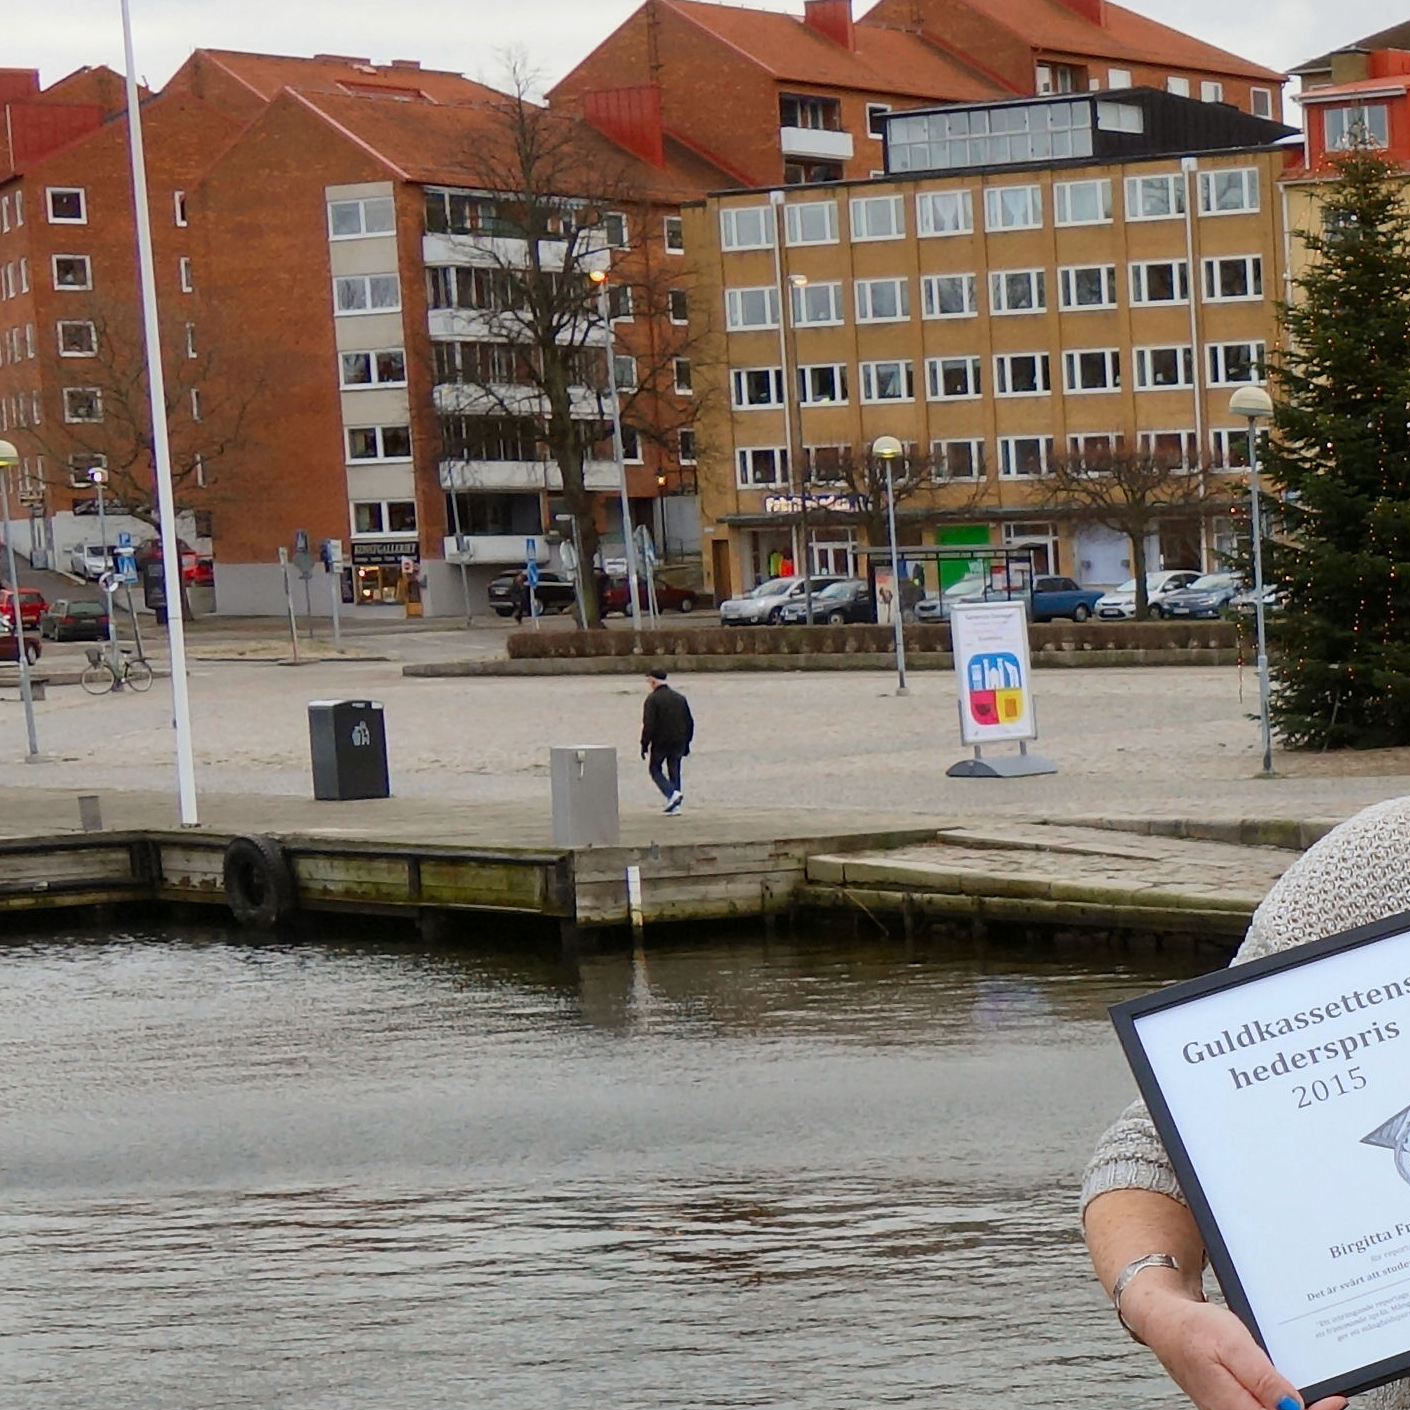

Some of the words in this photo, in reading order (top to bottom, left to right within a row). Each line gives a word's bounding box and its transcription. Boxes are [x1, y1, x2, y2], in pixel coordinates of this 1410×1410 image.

[1228, 1022, 1400, 1090] hederspris
[1292, 1066, 1367, 1109] 2015
[1329, 1231, 1393, 1259] Birgitta
[1307, 1290, 1325, 1301] Det
[1327, 1286, 1337, 1295] är
[1340, 1276, 1365, 1290] svårt
[1367, 1271, 1381, 1281] att
